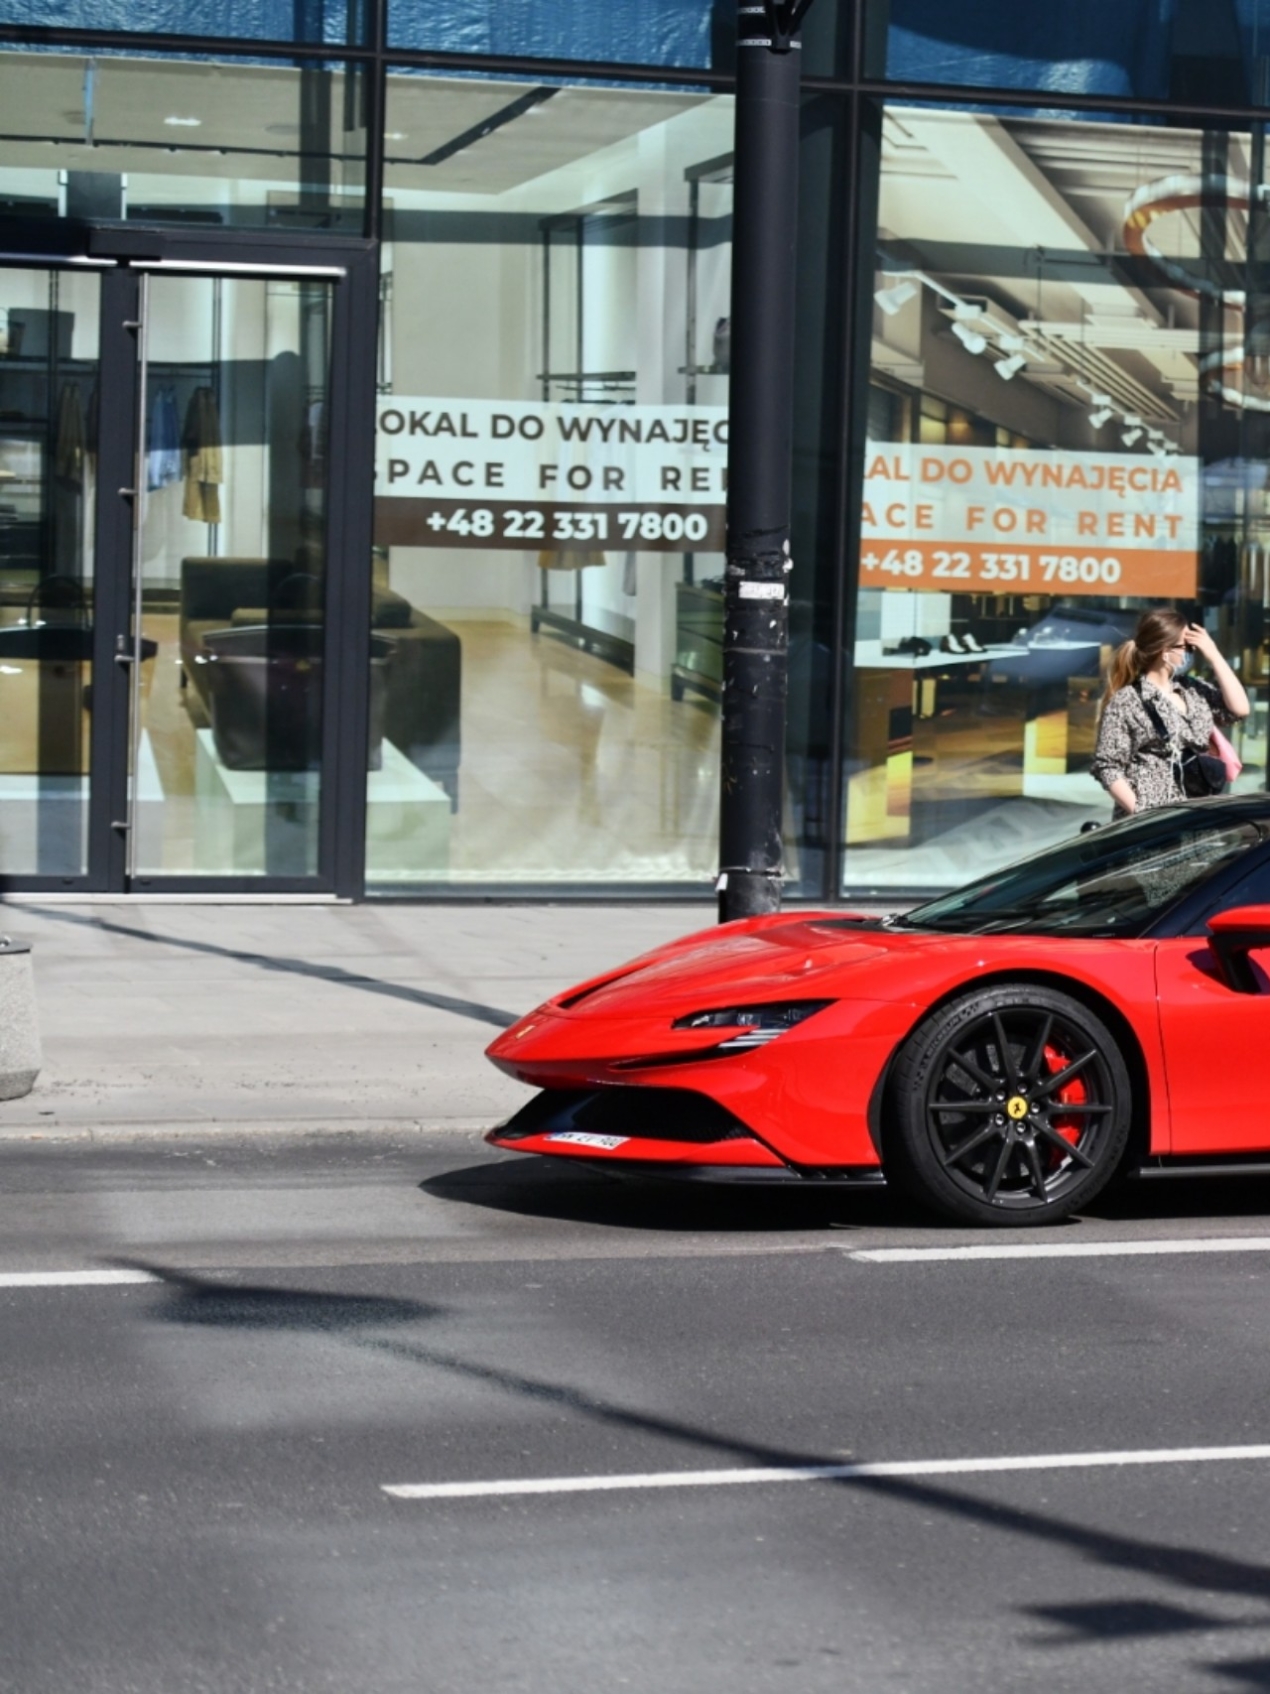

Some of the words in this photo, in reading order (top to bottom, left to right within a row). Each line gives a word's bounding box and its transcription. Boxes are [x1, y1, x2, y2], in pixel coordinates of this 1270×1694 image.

[374, 408, 479, 438] OKAL
[491, 413, 544, 440] DO
[374, 458, 505, 488] PACE
[539, 463, 625, 491] FOR
[660, 465, 728, 492] RE
[862, 455, 911, 482] AL
[920, 456, 973, 484] DO
[984, 459, 1183, 498] WYNAJĘCIA
[426, 508, 494, 537] +48
[502, 510, 545, 539] 22
[552, 511, 607, 540] 331
[617, 512, 708, 541] 7800
[966, 505, 1046, 534] FOR
[1077, 510, 1184, 540] RENT
[861, 548, 924, 577] +48
[931, 551, 971, 579] 22
[979, 553, 1030, 581] 331
[1038, 555, 1122, 584] 7800
